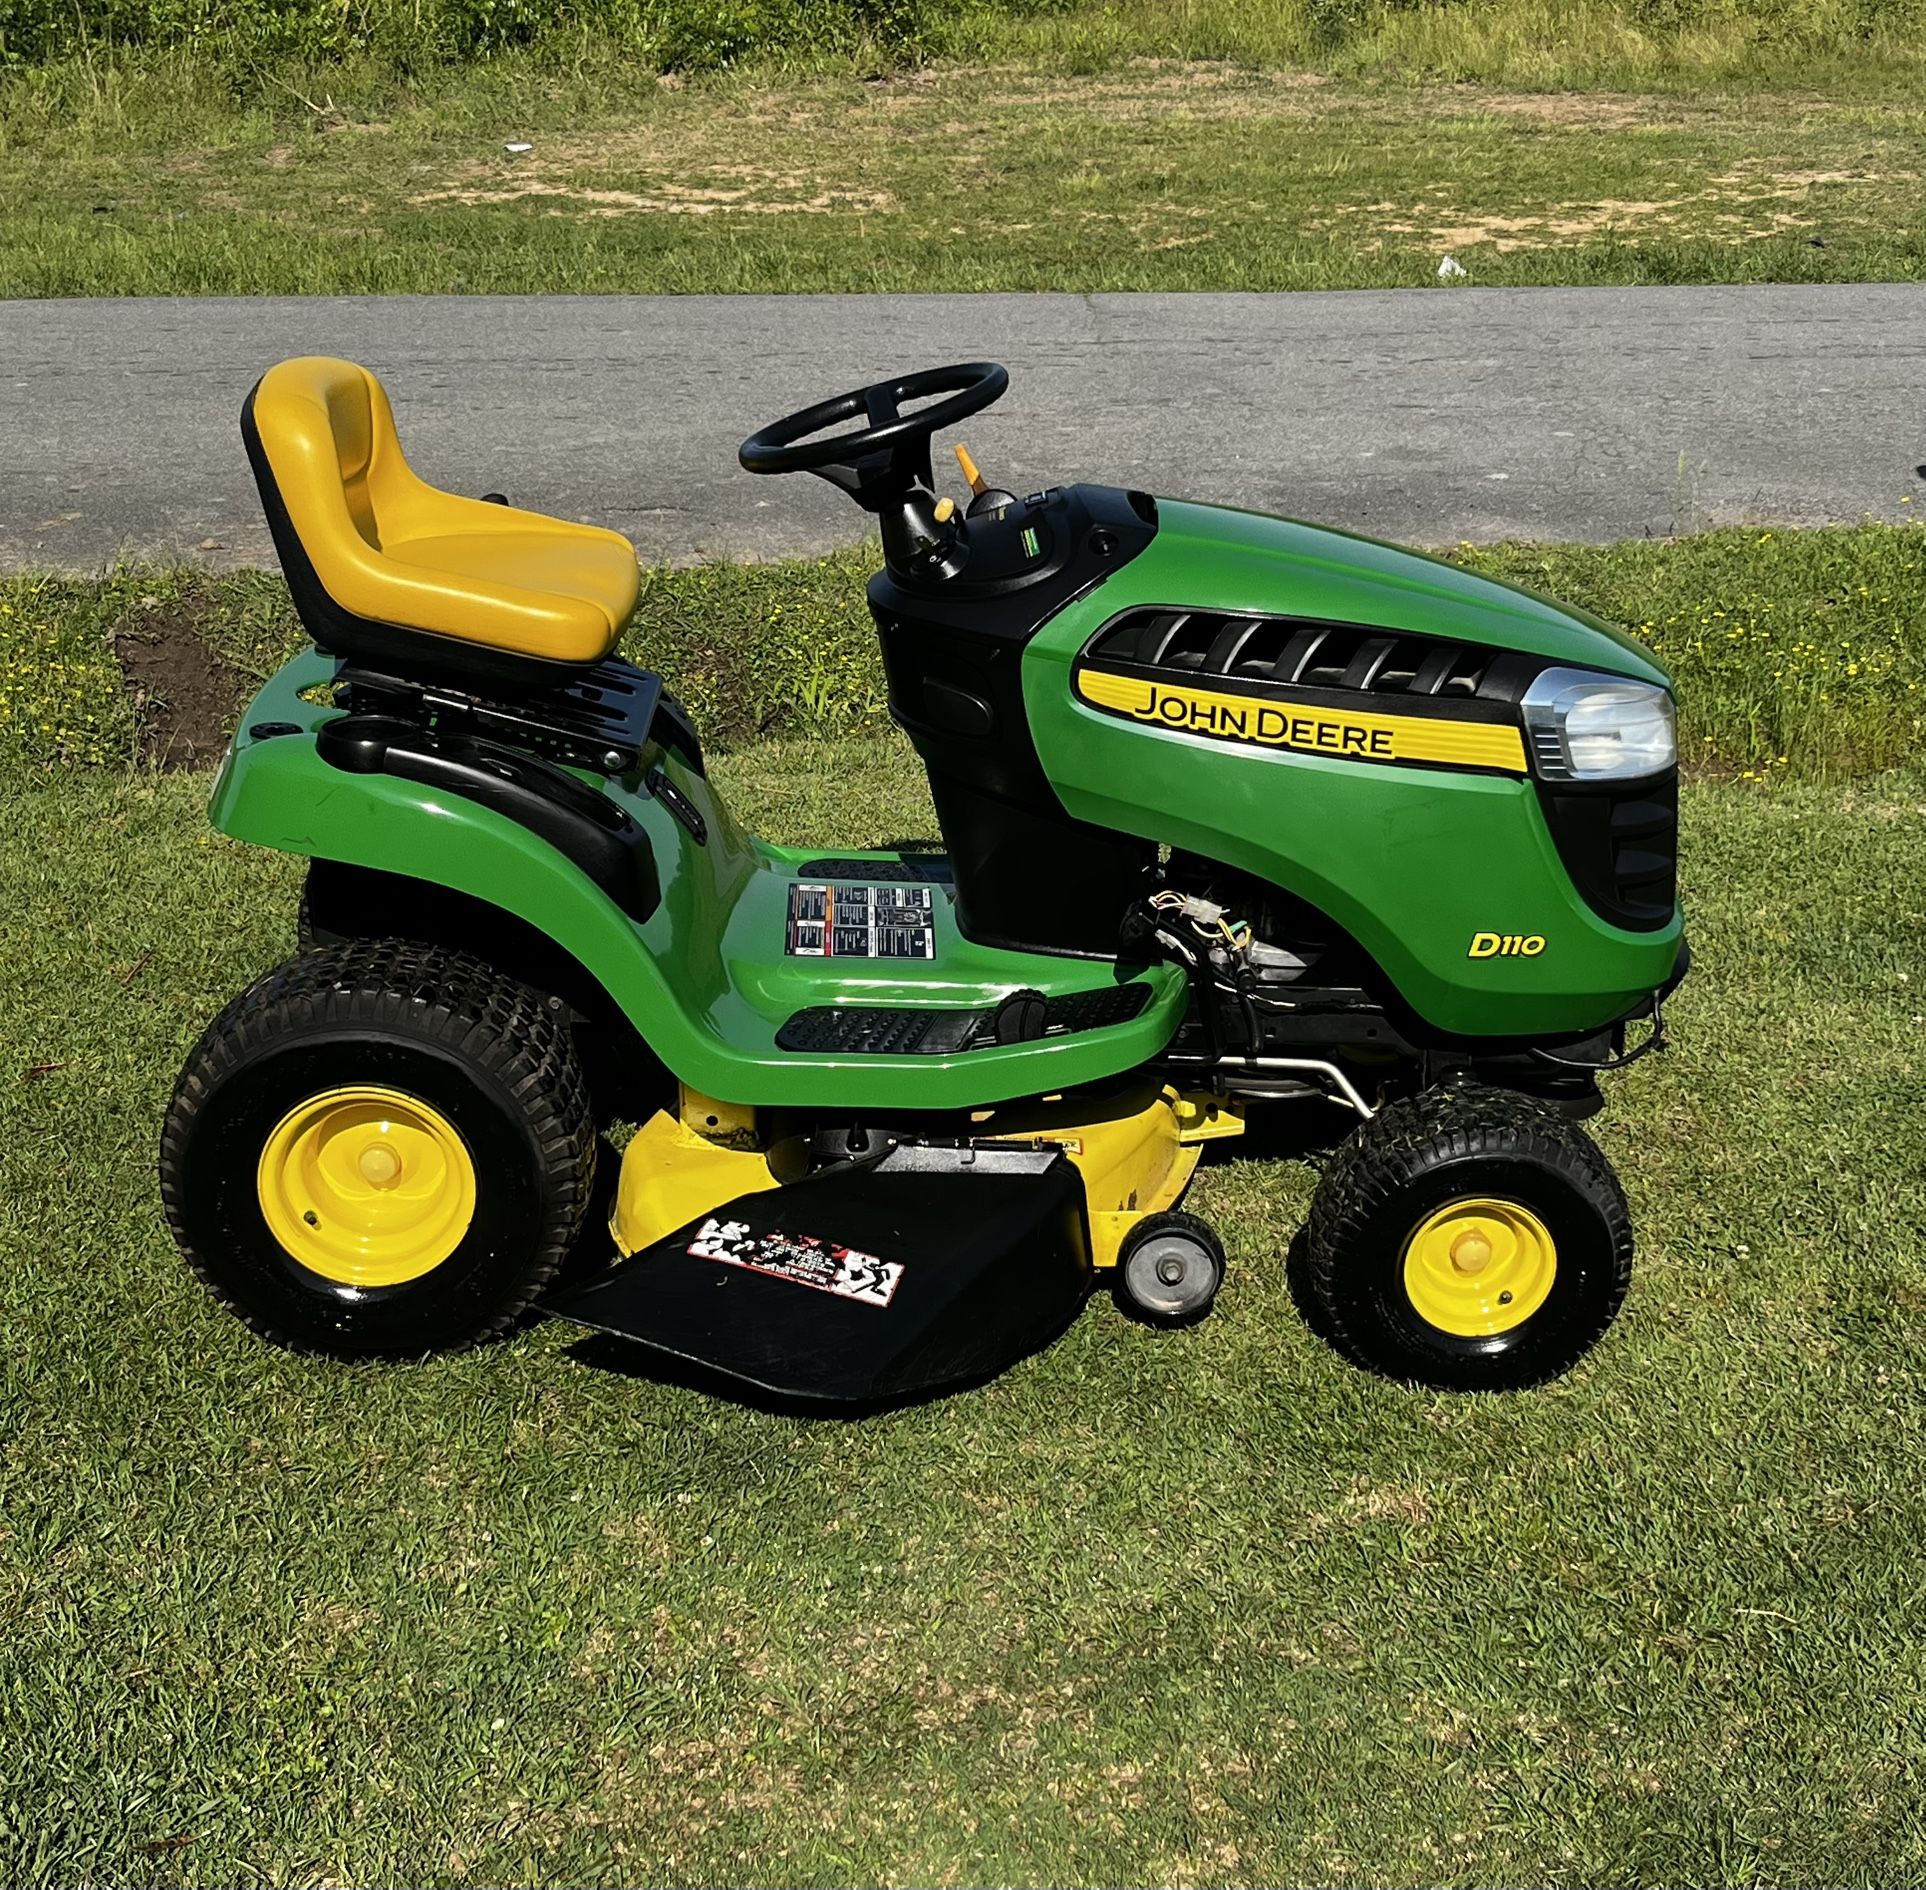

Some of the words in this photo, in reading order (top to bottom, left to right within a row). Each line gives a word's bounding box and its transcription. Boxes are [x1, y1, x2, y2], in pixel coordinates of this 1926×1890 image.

[1134, 686, 1247, 734] JOHN
[1257, 707, 1394, 755] DEERE
[1468, 932, 1546, 957] D110
